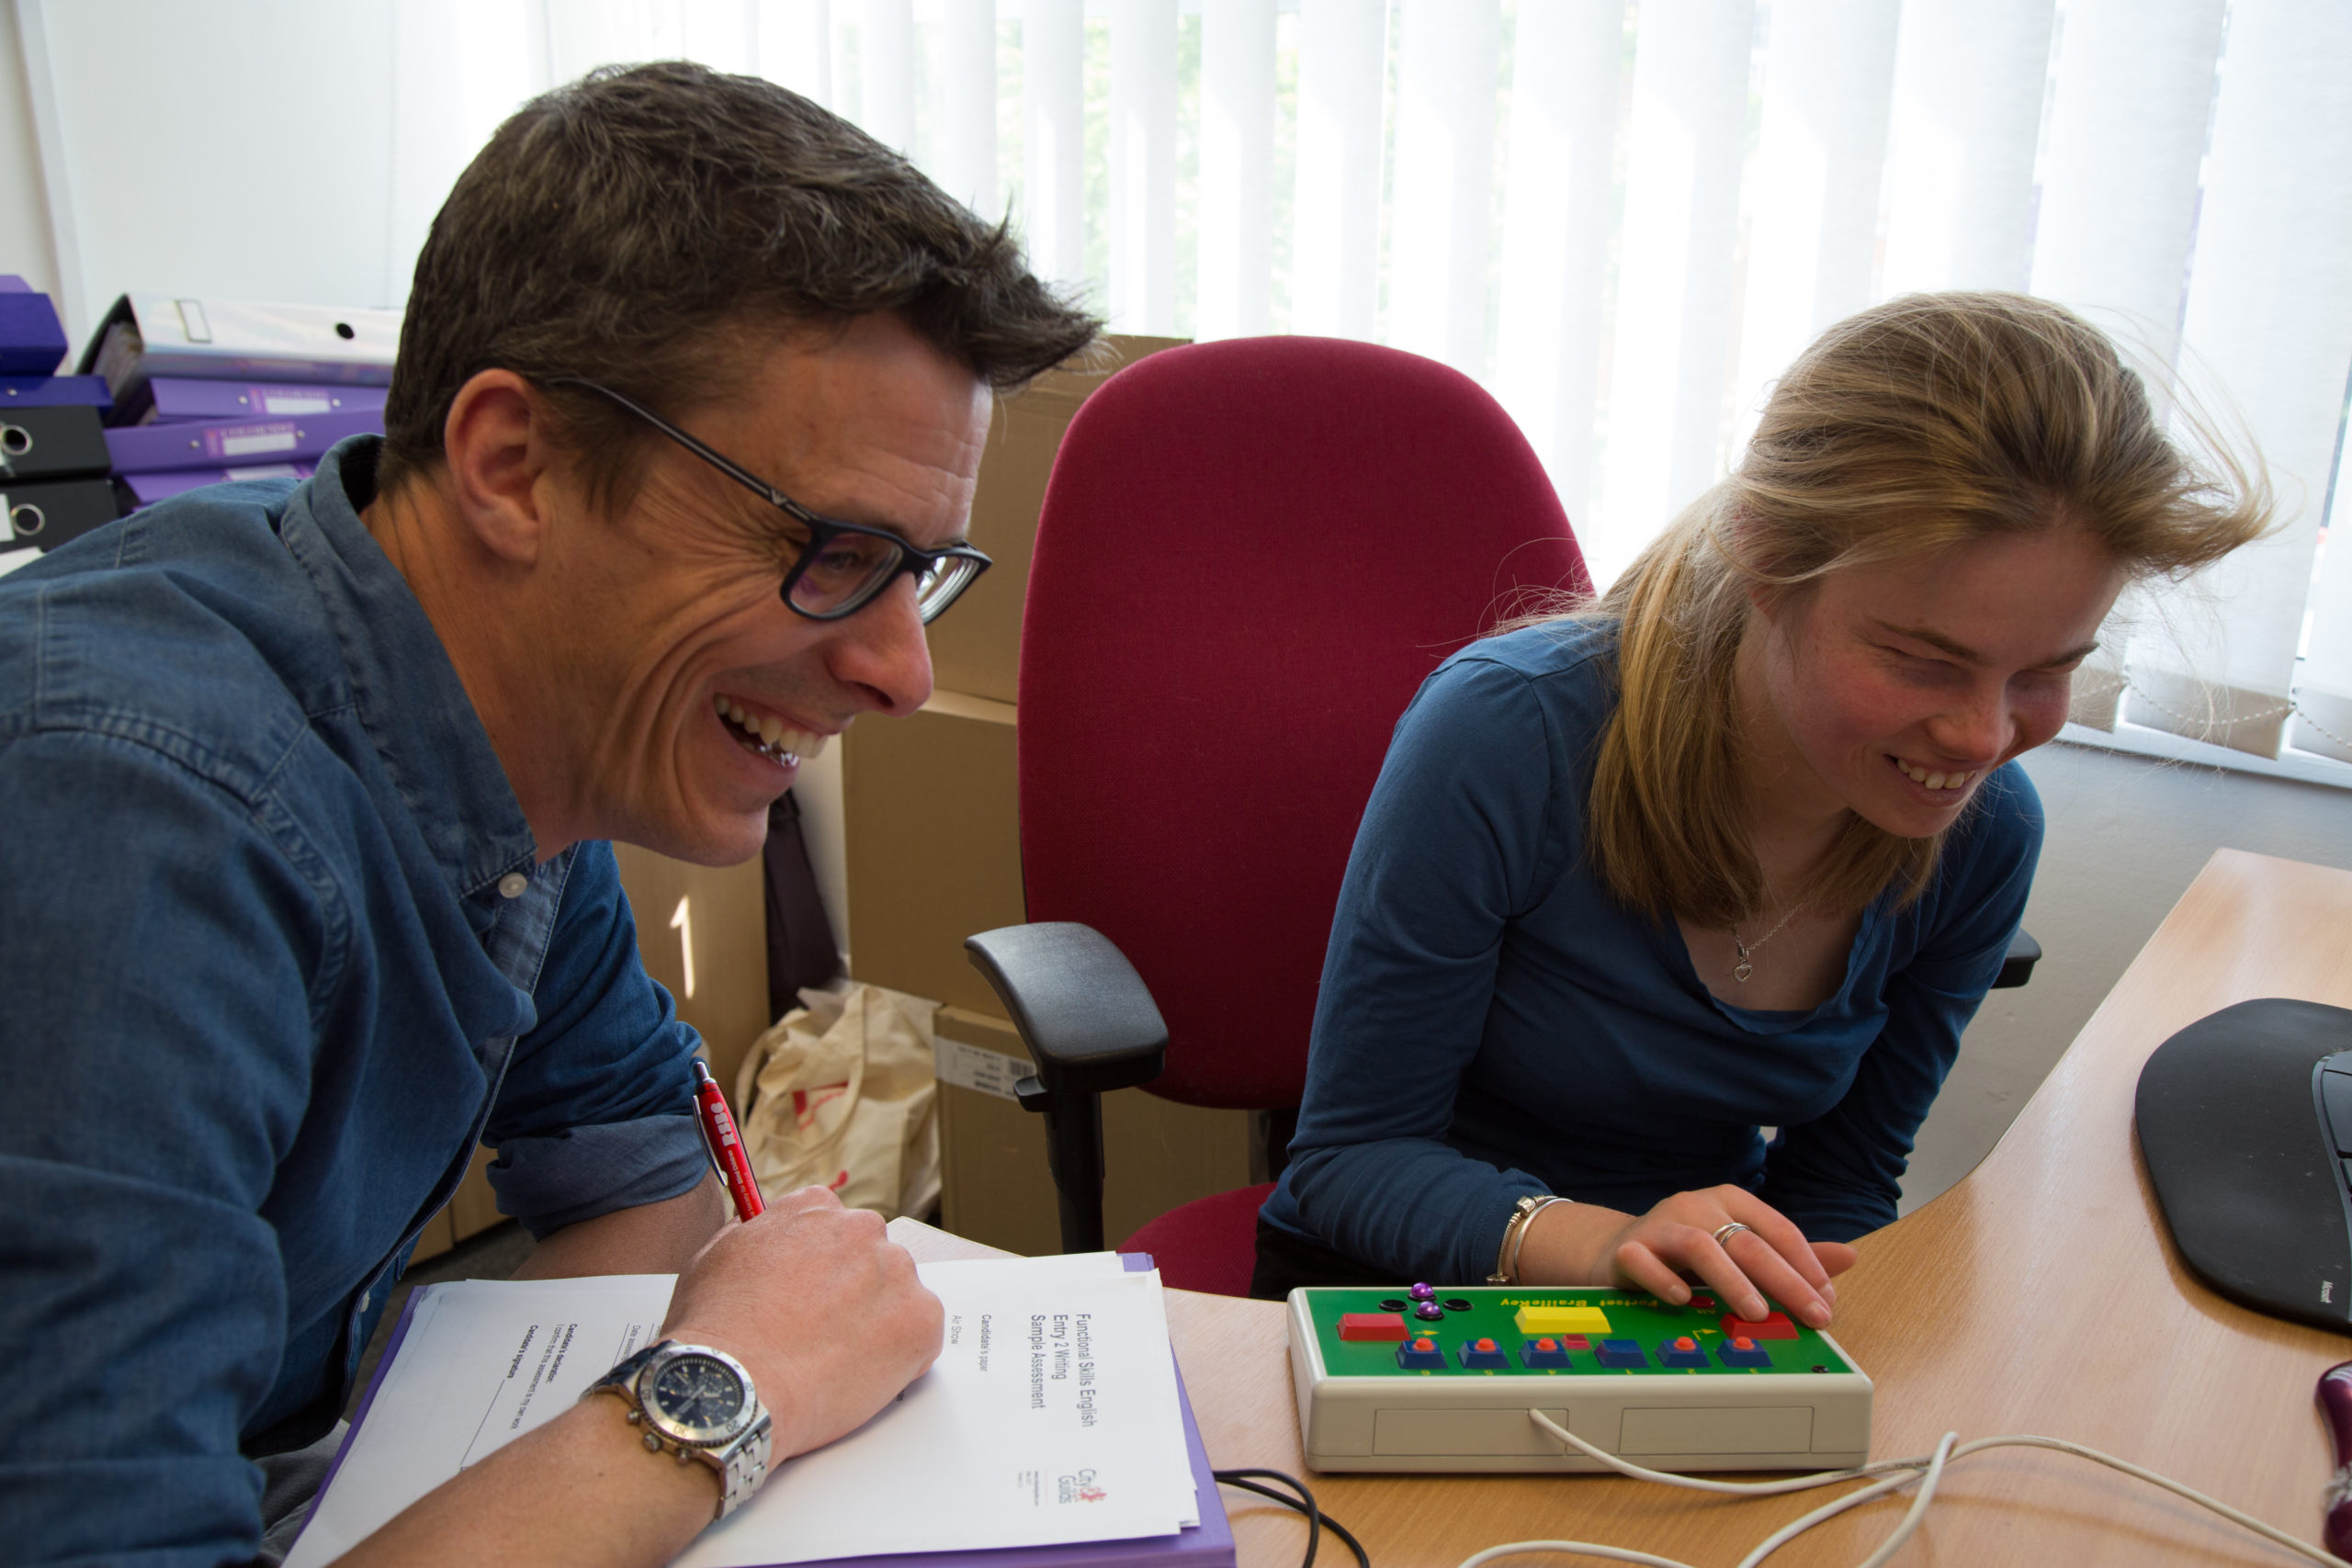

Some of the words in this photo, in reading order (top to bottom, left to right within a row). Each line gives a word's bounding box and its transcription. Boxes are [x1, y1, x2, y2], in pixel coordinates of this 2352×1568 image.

[710, 1102, 736, 1146] RSBC
[1500, 1297, 1588, 1309] BrailleKey
[1599, 1299, 1658, 1307] Portset
[629, 1325, 641, 1337] Date
[951, 1315, 962, 1325] Air
[1028, 1314, 1046, 1350] Sample
[1050, 1314, 1069, 1339] Entry
[518, 1325, 538, 1353] Candidate's
[548, 1327, 562, 1344] confirm
[559, 1324, 578, 1353] Candidate's
[951, 1325, 961, 1345] Show
[979, 1314, 991, 1355] Candidate's
[1076, 1314, 1093, 1359] Functional
[540, 1355, 551, 1363] this
[545, 1345, 555, 1354] that
[507, 1354, 526, 1379] signature
[546, 1354, 565, 1383] declaration:
[978, 1356, 989, 1372] paper
[1051, 1349, 1069, 1380] Writing
[1078, 1362, 1095, 1386] Skills
[526, 1364, 548, 1393] assessment
[1031, 1352, 1046, 1408] Assessment
[519, 1398, 532, 1406] my
[1076, 1390, 1098, 1427] English
[1058, 1475, 1077, 1504] Guilds
[1074, 1469, 1097, 1487] City
